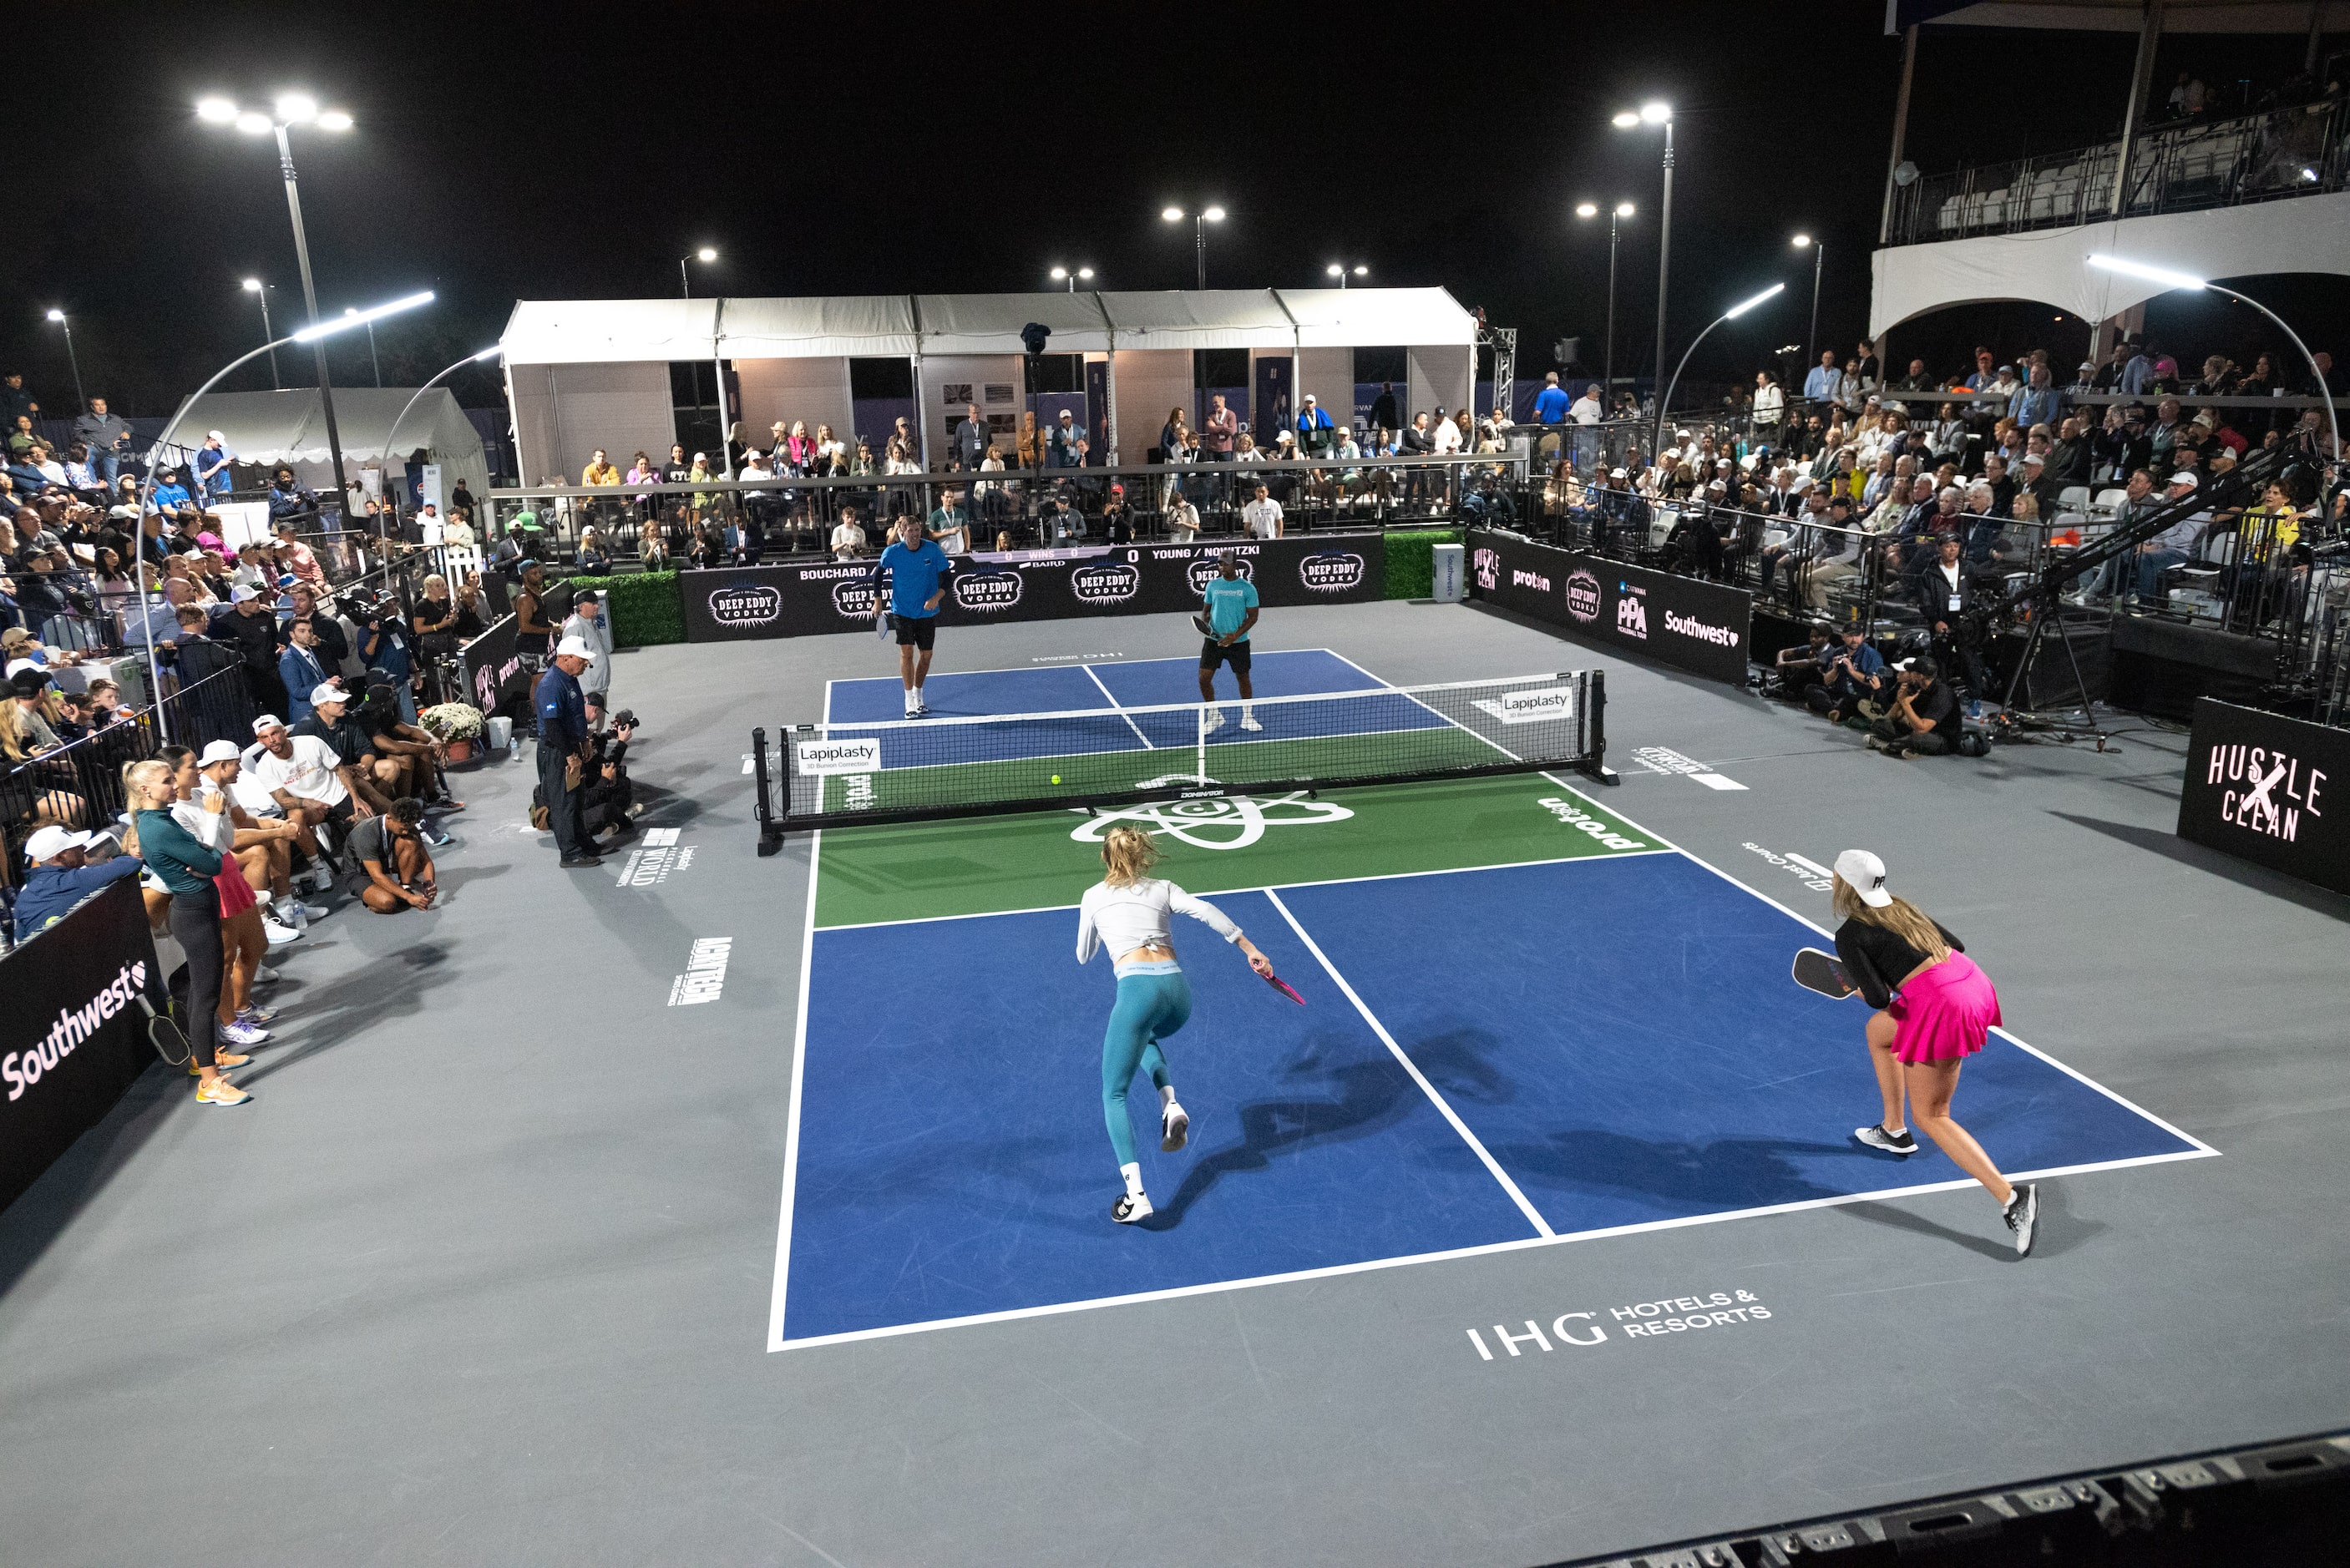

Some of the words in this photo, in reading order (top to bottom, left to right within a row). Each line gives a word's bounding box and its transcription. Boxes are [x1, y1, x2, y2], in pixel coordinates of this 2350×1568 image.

[1028, 549, 1056, 559] WINS
[1127, 549, 1139, 563] 0
[1152, 548, 1192, 559] YOUNG
[1032, 559, 1066, 569] BAIRD
[1308, 564, 1331, 576] DEEP
[1333, 563, 1356, 574] EDDY
[1474, 548, 1501, 576] HUSTLE
[800, 567, 866, 580] BOUCHARD
[1081, 576, 1104, 588] DEEP
[1107, 574, 1131, 586] EDDY
[1196, 569, 1219, 582] DEEP
[1312, 574, 1353, 584] VODKA
[1478, 570, 1496, 590] CLEAN
[963, 583, 987, 595] DEEP
[989, 581, 1014, 593] EDDY
[1085, 586, 1128, 595] VODKA
[1571, 586, 1583, 599] DEEP
[1583, 589, 1597, 604] EDDY
[1626, 584, 1647, 596] CARVANA
[718, 597, 744, 611] DEEP
[746, 596, 772, 609] EDDY
[842, 590, 867, 603] DEEP
[869, 589, 893, 600] EDY
[967, 594, 1011, 602] VODKA
[847, 602, 892, 610] VODA
[1572, 600, 1595, 613] VODKA
[723, 609, 770, 619] VODKA
[1618, 597, 1648, 633] PPA
[1618, 625, 1637, 638] PICKLEBALL
[1664, 609, 1730, 647] Southwest
[1504, 694, 1568, 711] Lapiplasty
[801, 745, 874, 762] Lapiplasty
[816, 761, 838, 770] Bunion
[838, 761, 869, 769] Correction
[2207, 744, 2327, 817] HUSTLE
[1180, 789, 1224, 799] DOMINATOR
[2222, 789, 2299, 842] CLEAN
[1537, 797, 1647, 850] proton
[672, 845, 698, 871] Lapiplasty
[1741, 842, 1788, 865] Courts
[631, 846, 669, 886] WORLD
[656, 846, 678, 883] PICKLEBALL
[1782, 864, 1819, 880] Just
[677, 936, 733, 1006] ACRYTECH
[2, 966, 135, 1102] Southwest
[1610, 1292, 1733, 1322] HOTELS
[1735, 1289, 1760, 1303] &
[1623, 1305, 1773, 1338] RESORTS
[1466, 1312, 1609, 1361] IHG
